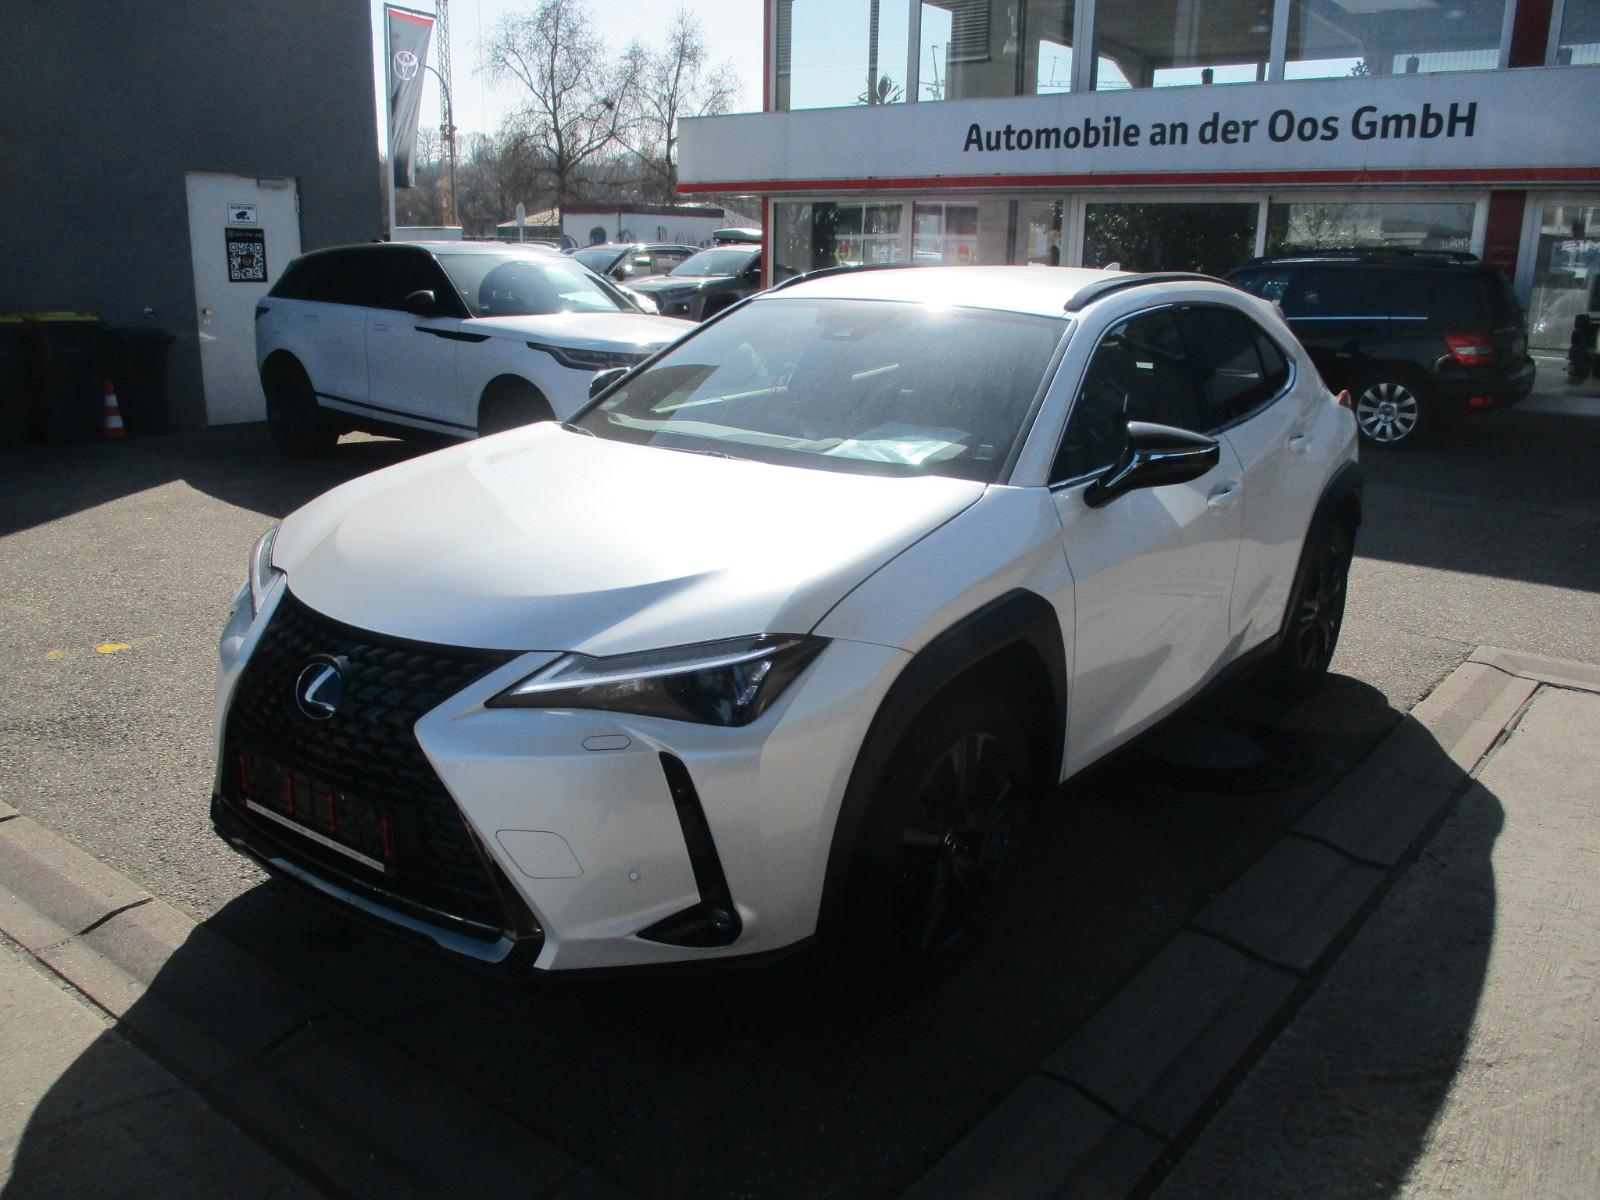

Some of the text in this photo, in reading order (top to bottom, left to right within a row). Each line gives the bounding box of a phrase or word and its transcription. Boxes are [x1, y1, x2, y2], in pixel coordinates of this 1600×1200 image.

[963, 101, 1478, 153] Automobile an der Oos GmbH
